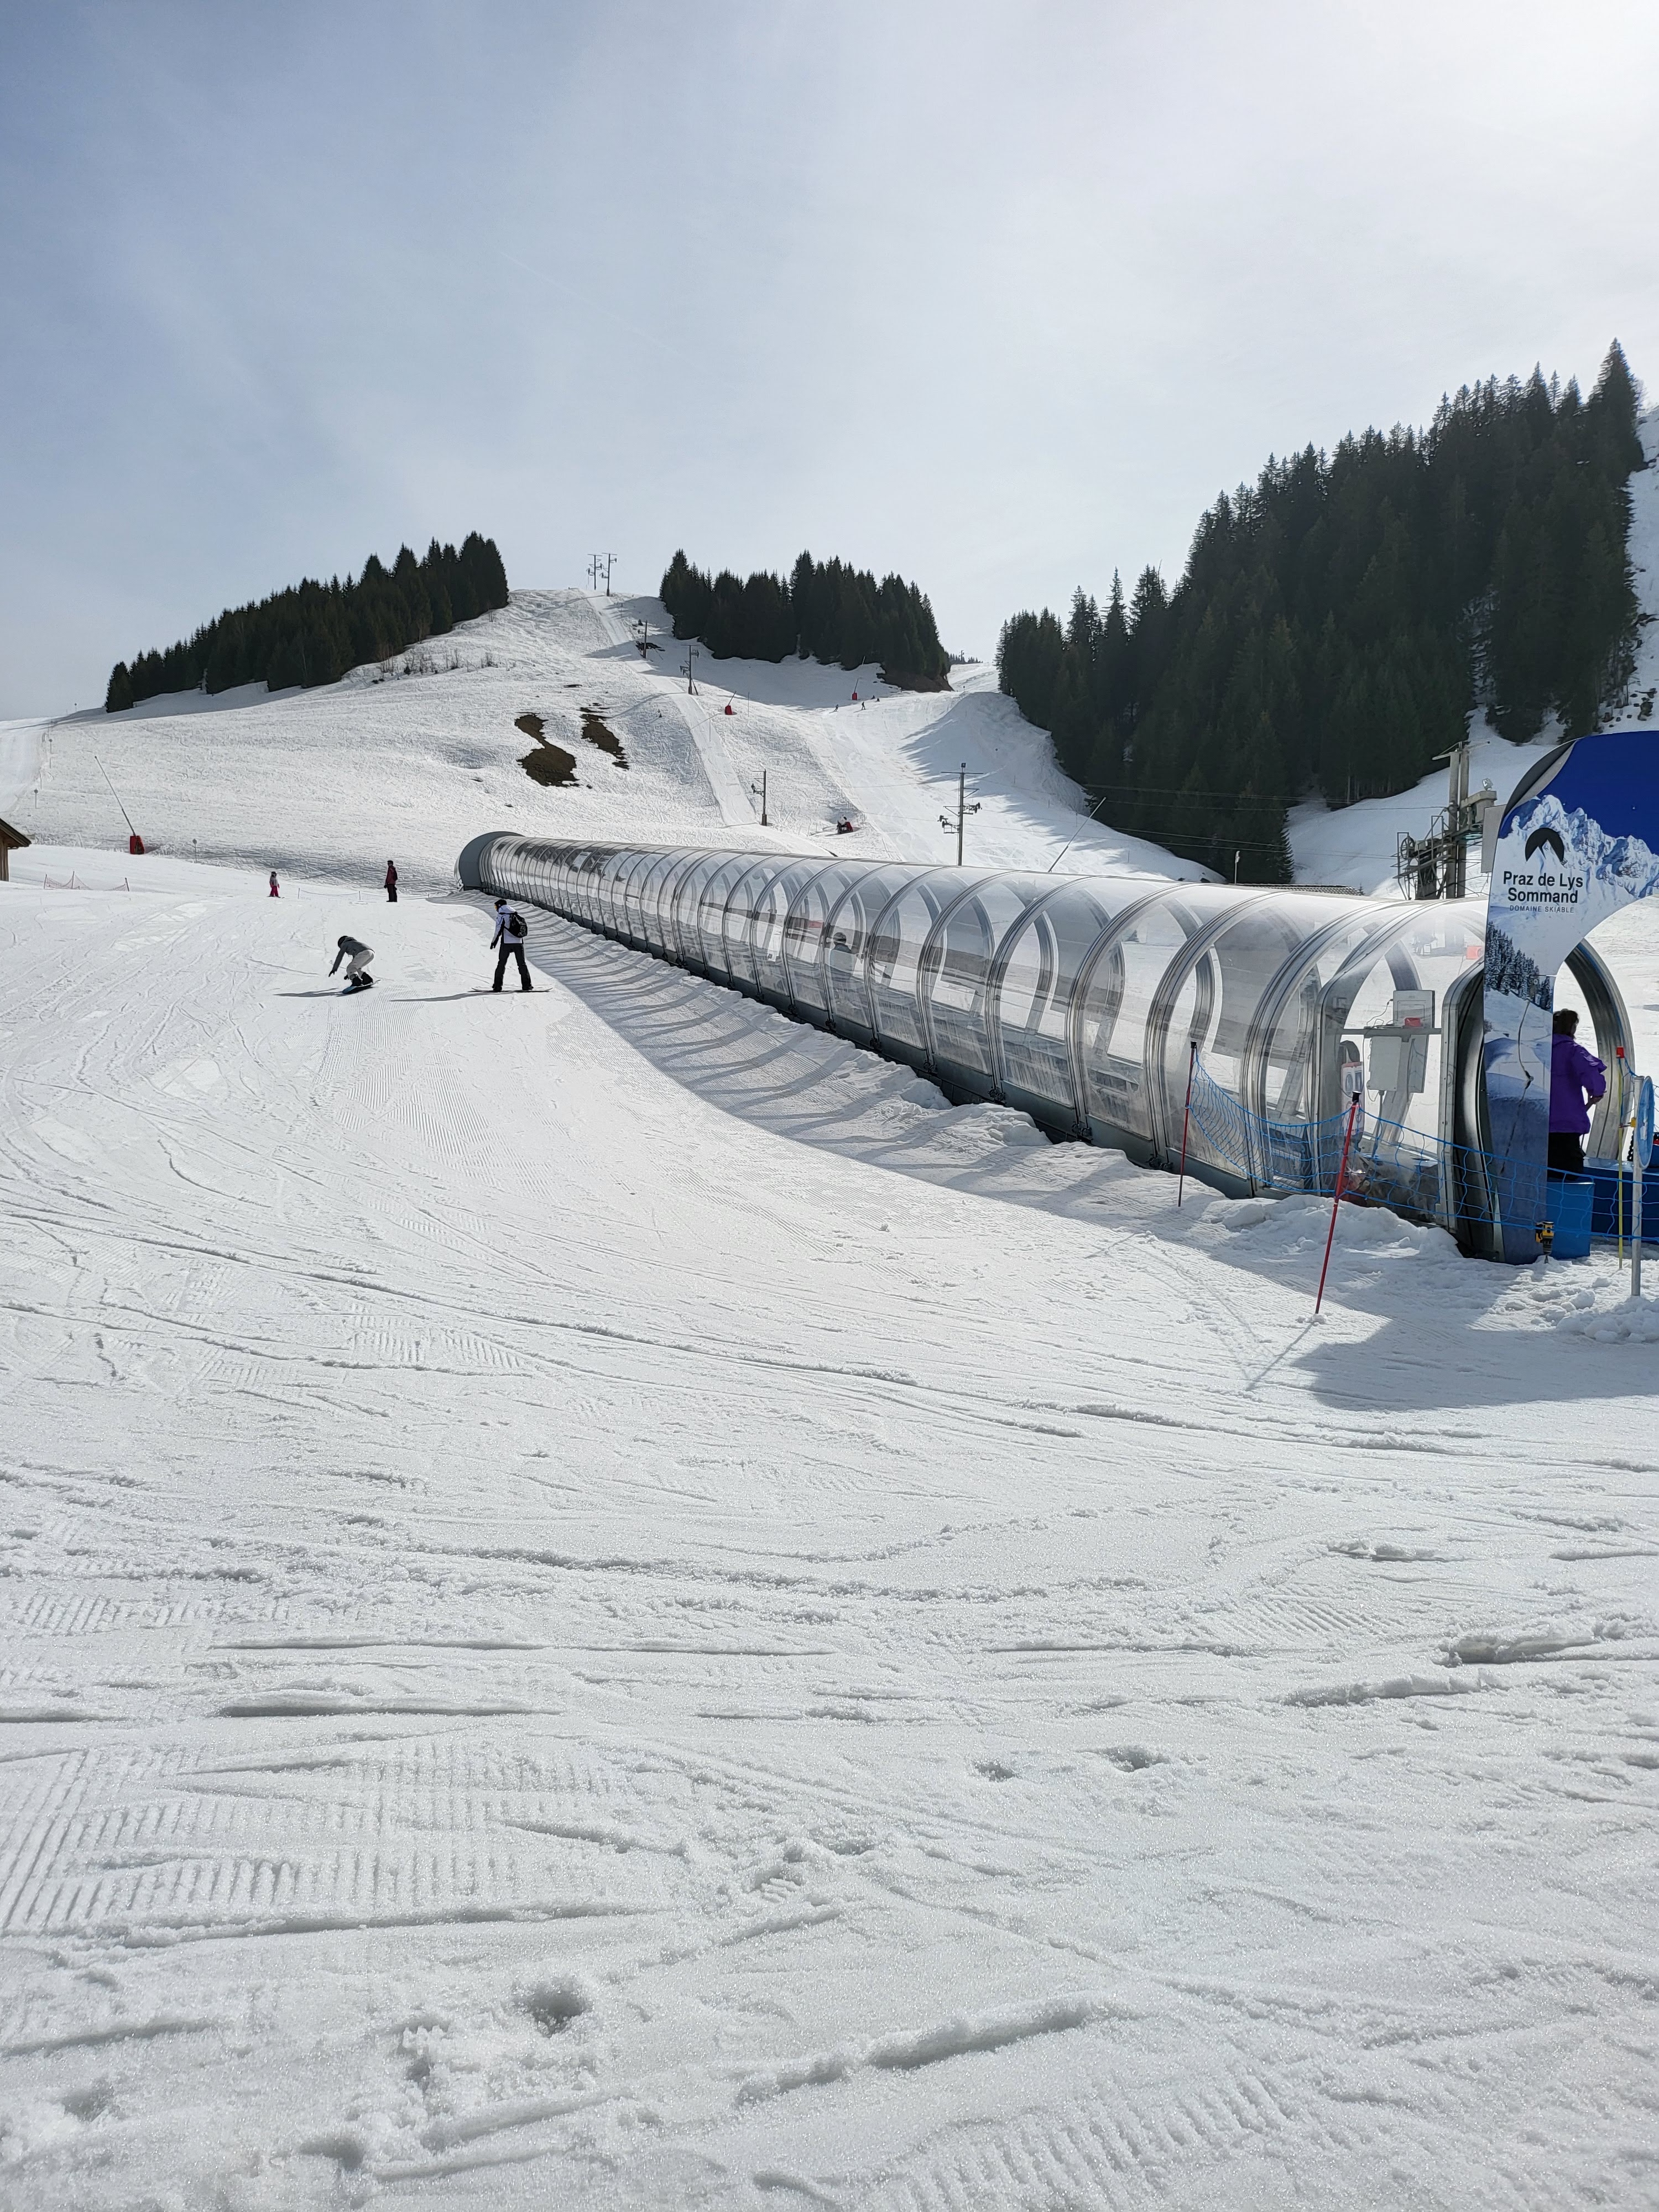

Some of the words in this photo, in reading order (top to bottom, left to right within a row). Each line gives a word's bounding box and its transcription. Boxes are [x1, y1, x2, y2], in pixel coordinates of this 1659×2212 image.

[1503, 870, 1533, 885] Praz
[1538, 873, 1555, 886] de
[1559, 873, 1583, 890] Lys
[1507, 887, 1578, 903] Sommand
